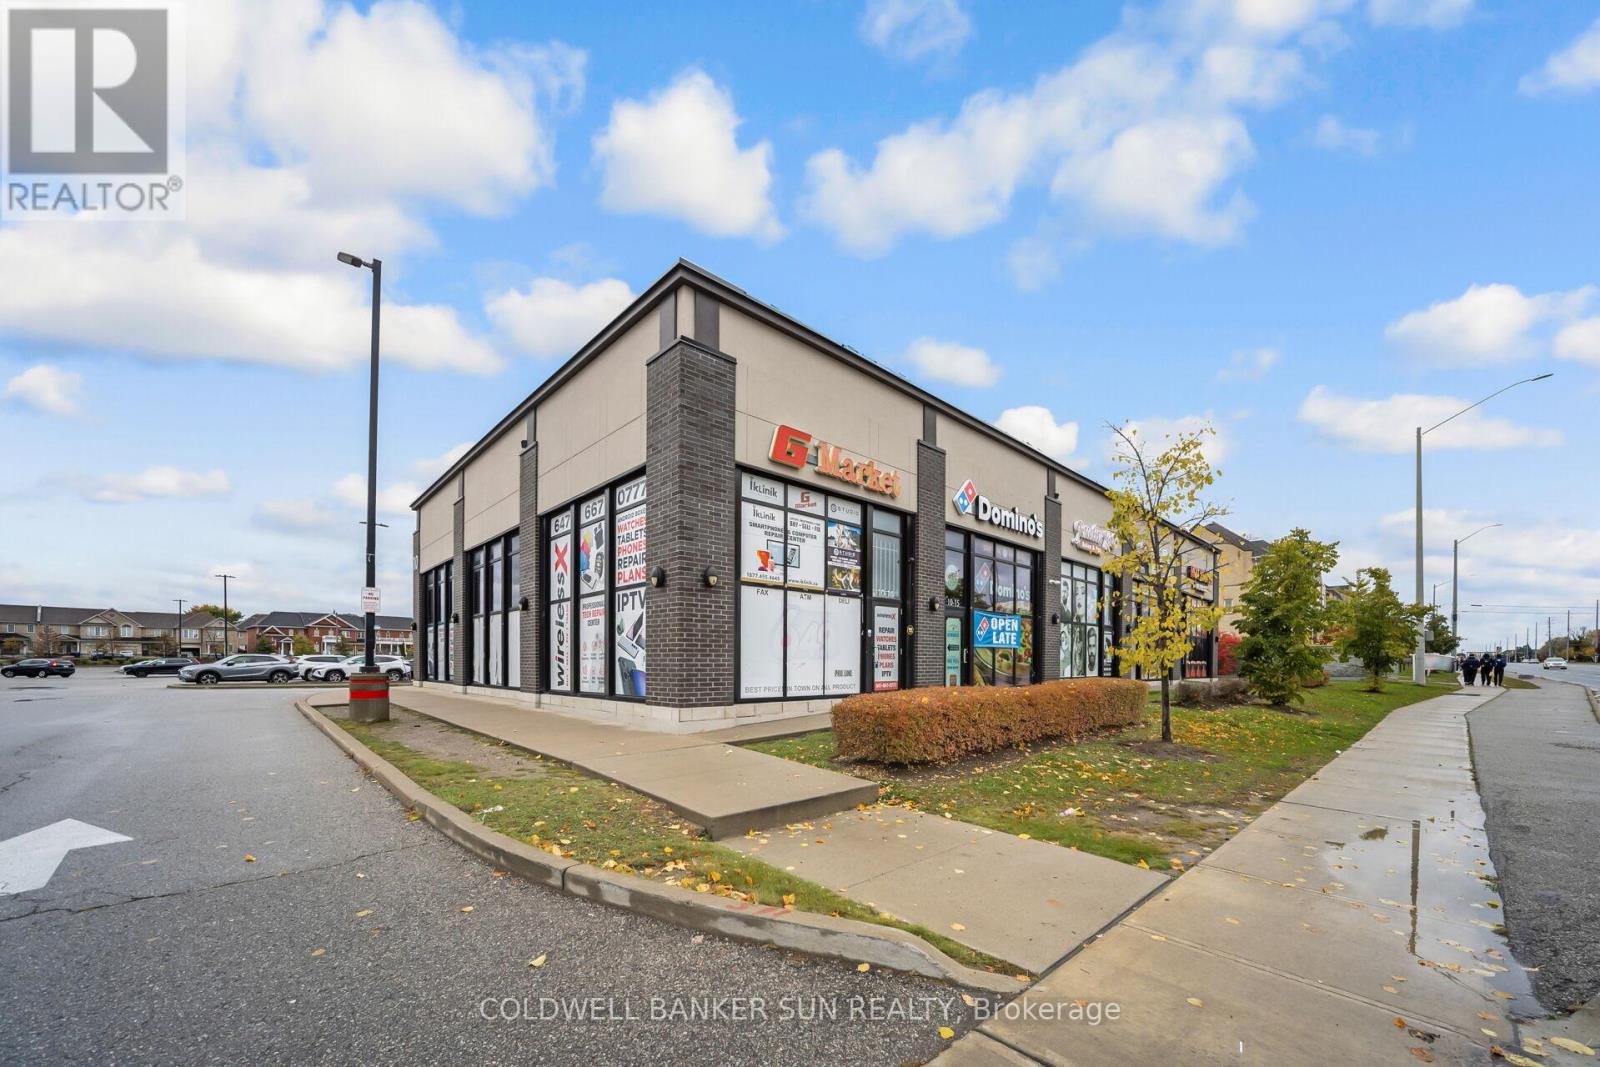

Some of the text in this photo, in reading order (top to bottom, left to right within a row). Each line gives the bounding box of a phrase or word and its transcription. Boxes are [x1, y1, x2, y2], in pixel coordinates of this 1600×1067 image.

[769, 425, 901, 498] G Market
[618, 481, 646, 505] 0777
[585, 499, 604, 520] 667
[978, 495, 1043, 538] Domino's
[555, 515, 570, 533] 647
[618, 566, 646, 585] PLANS
[991, 617, 1018, 631] OPEN
[992, 631, 1017, 645] LATE
